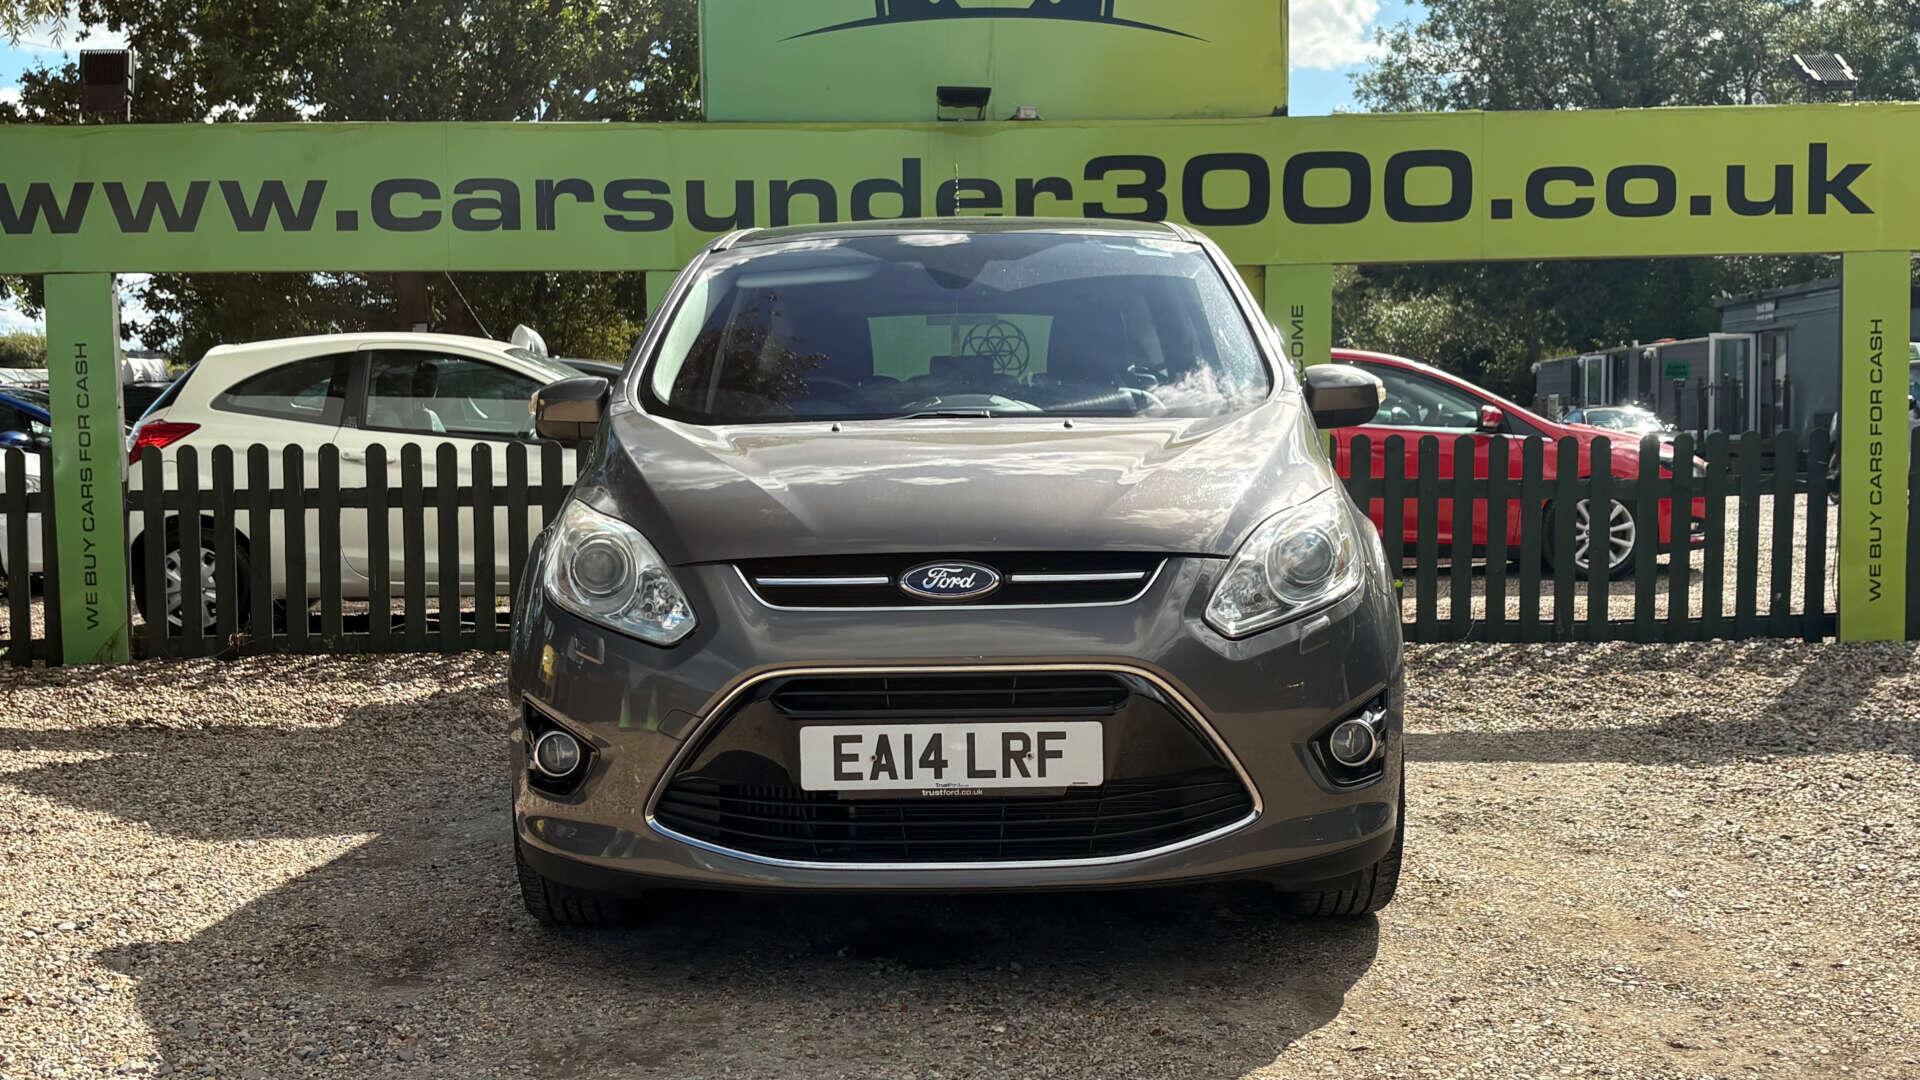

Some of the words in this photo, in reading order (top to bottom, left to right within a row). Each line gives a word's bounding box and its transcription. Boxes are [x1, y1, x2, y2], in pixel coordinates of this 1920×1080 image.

[0, 142, 1875, 234] www.carsunder3000.co.uk
[1870, 319, 1882, 383] CASH
[75, 343, 89, 408] CASH
[1870, 389, 1882, 435] FOR
[78, 414, 92, 461] FOR
[1869, 442, 1882, 505] CARS
[80, 467, 95, 532] CARS
[1869, 511, 1882, 558] BUY
[83, 538, 97, 585] BUY
[922, 567, 976, 588] Ford
[1869, 564, 1882, 602] WE
[85, 592, 99, 630] WE
[833, 733, 949, 781] EA14
[966, 731, 1067, 778] LRF
[921, 788, 983, 796] trustford.co.uk
